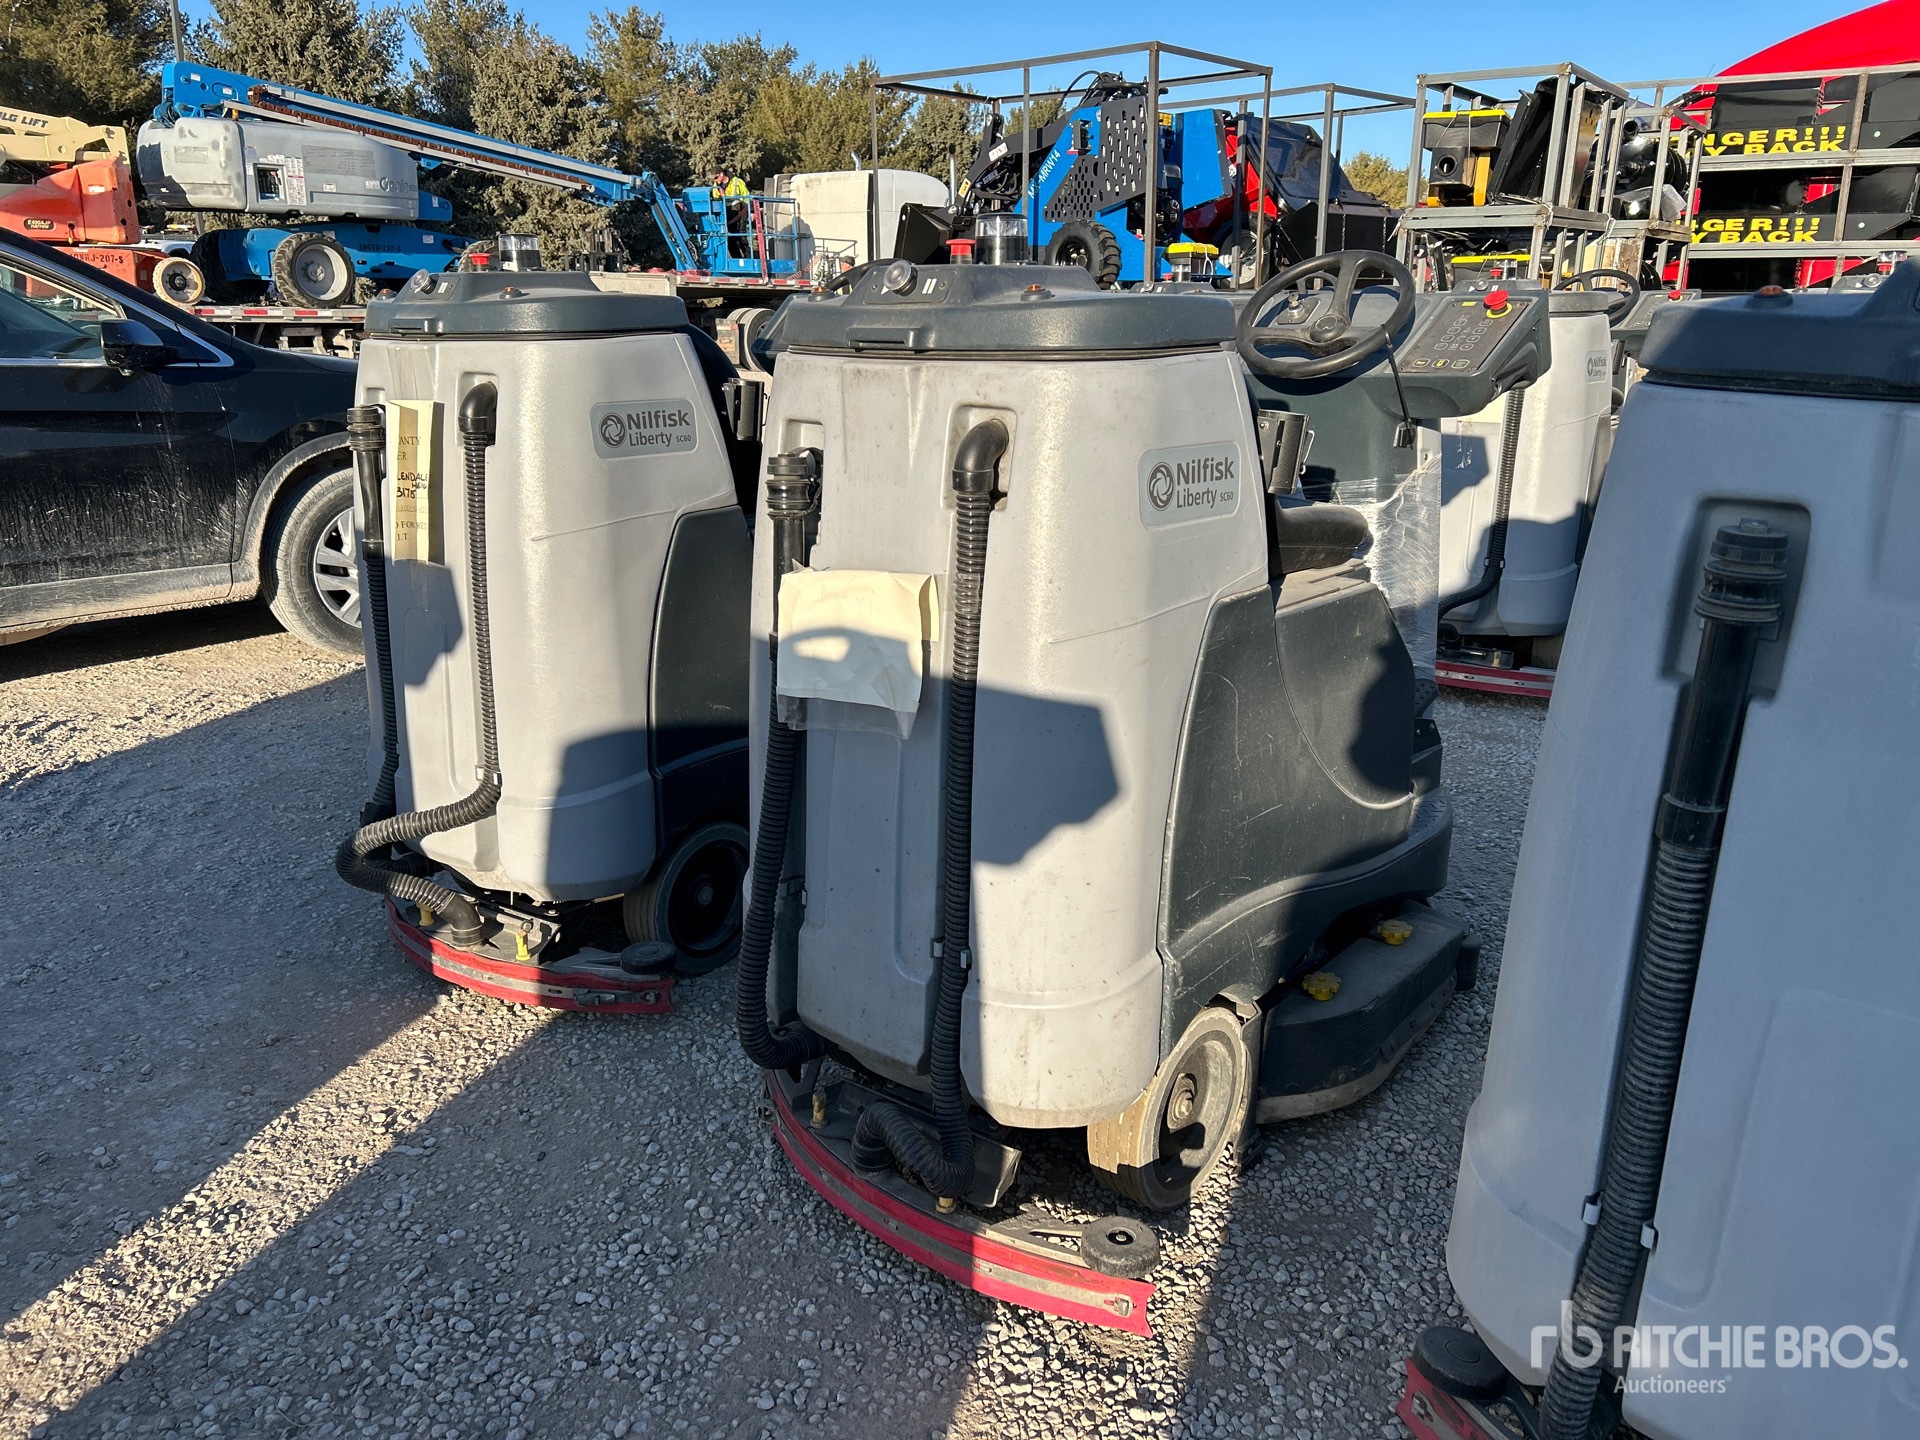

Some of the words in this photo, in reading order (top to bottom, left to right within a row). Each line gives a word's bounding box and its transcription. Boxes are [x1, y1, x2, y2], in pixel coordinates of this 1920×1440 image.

[21, 116, 48, 128] LIFT
[1743, 139, 1844, 155] BACK
[1720, 230, 1817, 243] BACK
[626, 409, 691, 430] Nilfisk
[629, 431, 672, 448] Liberty
[675, 434, 692, 443] SC60
[1176, 456, 1235, 486] Nilfisk
[1177, 487, 1218, 509] Liberty
[1220, 491, 1234, 502] SC60
